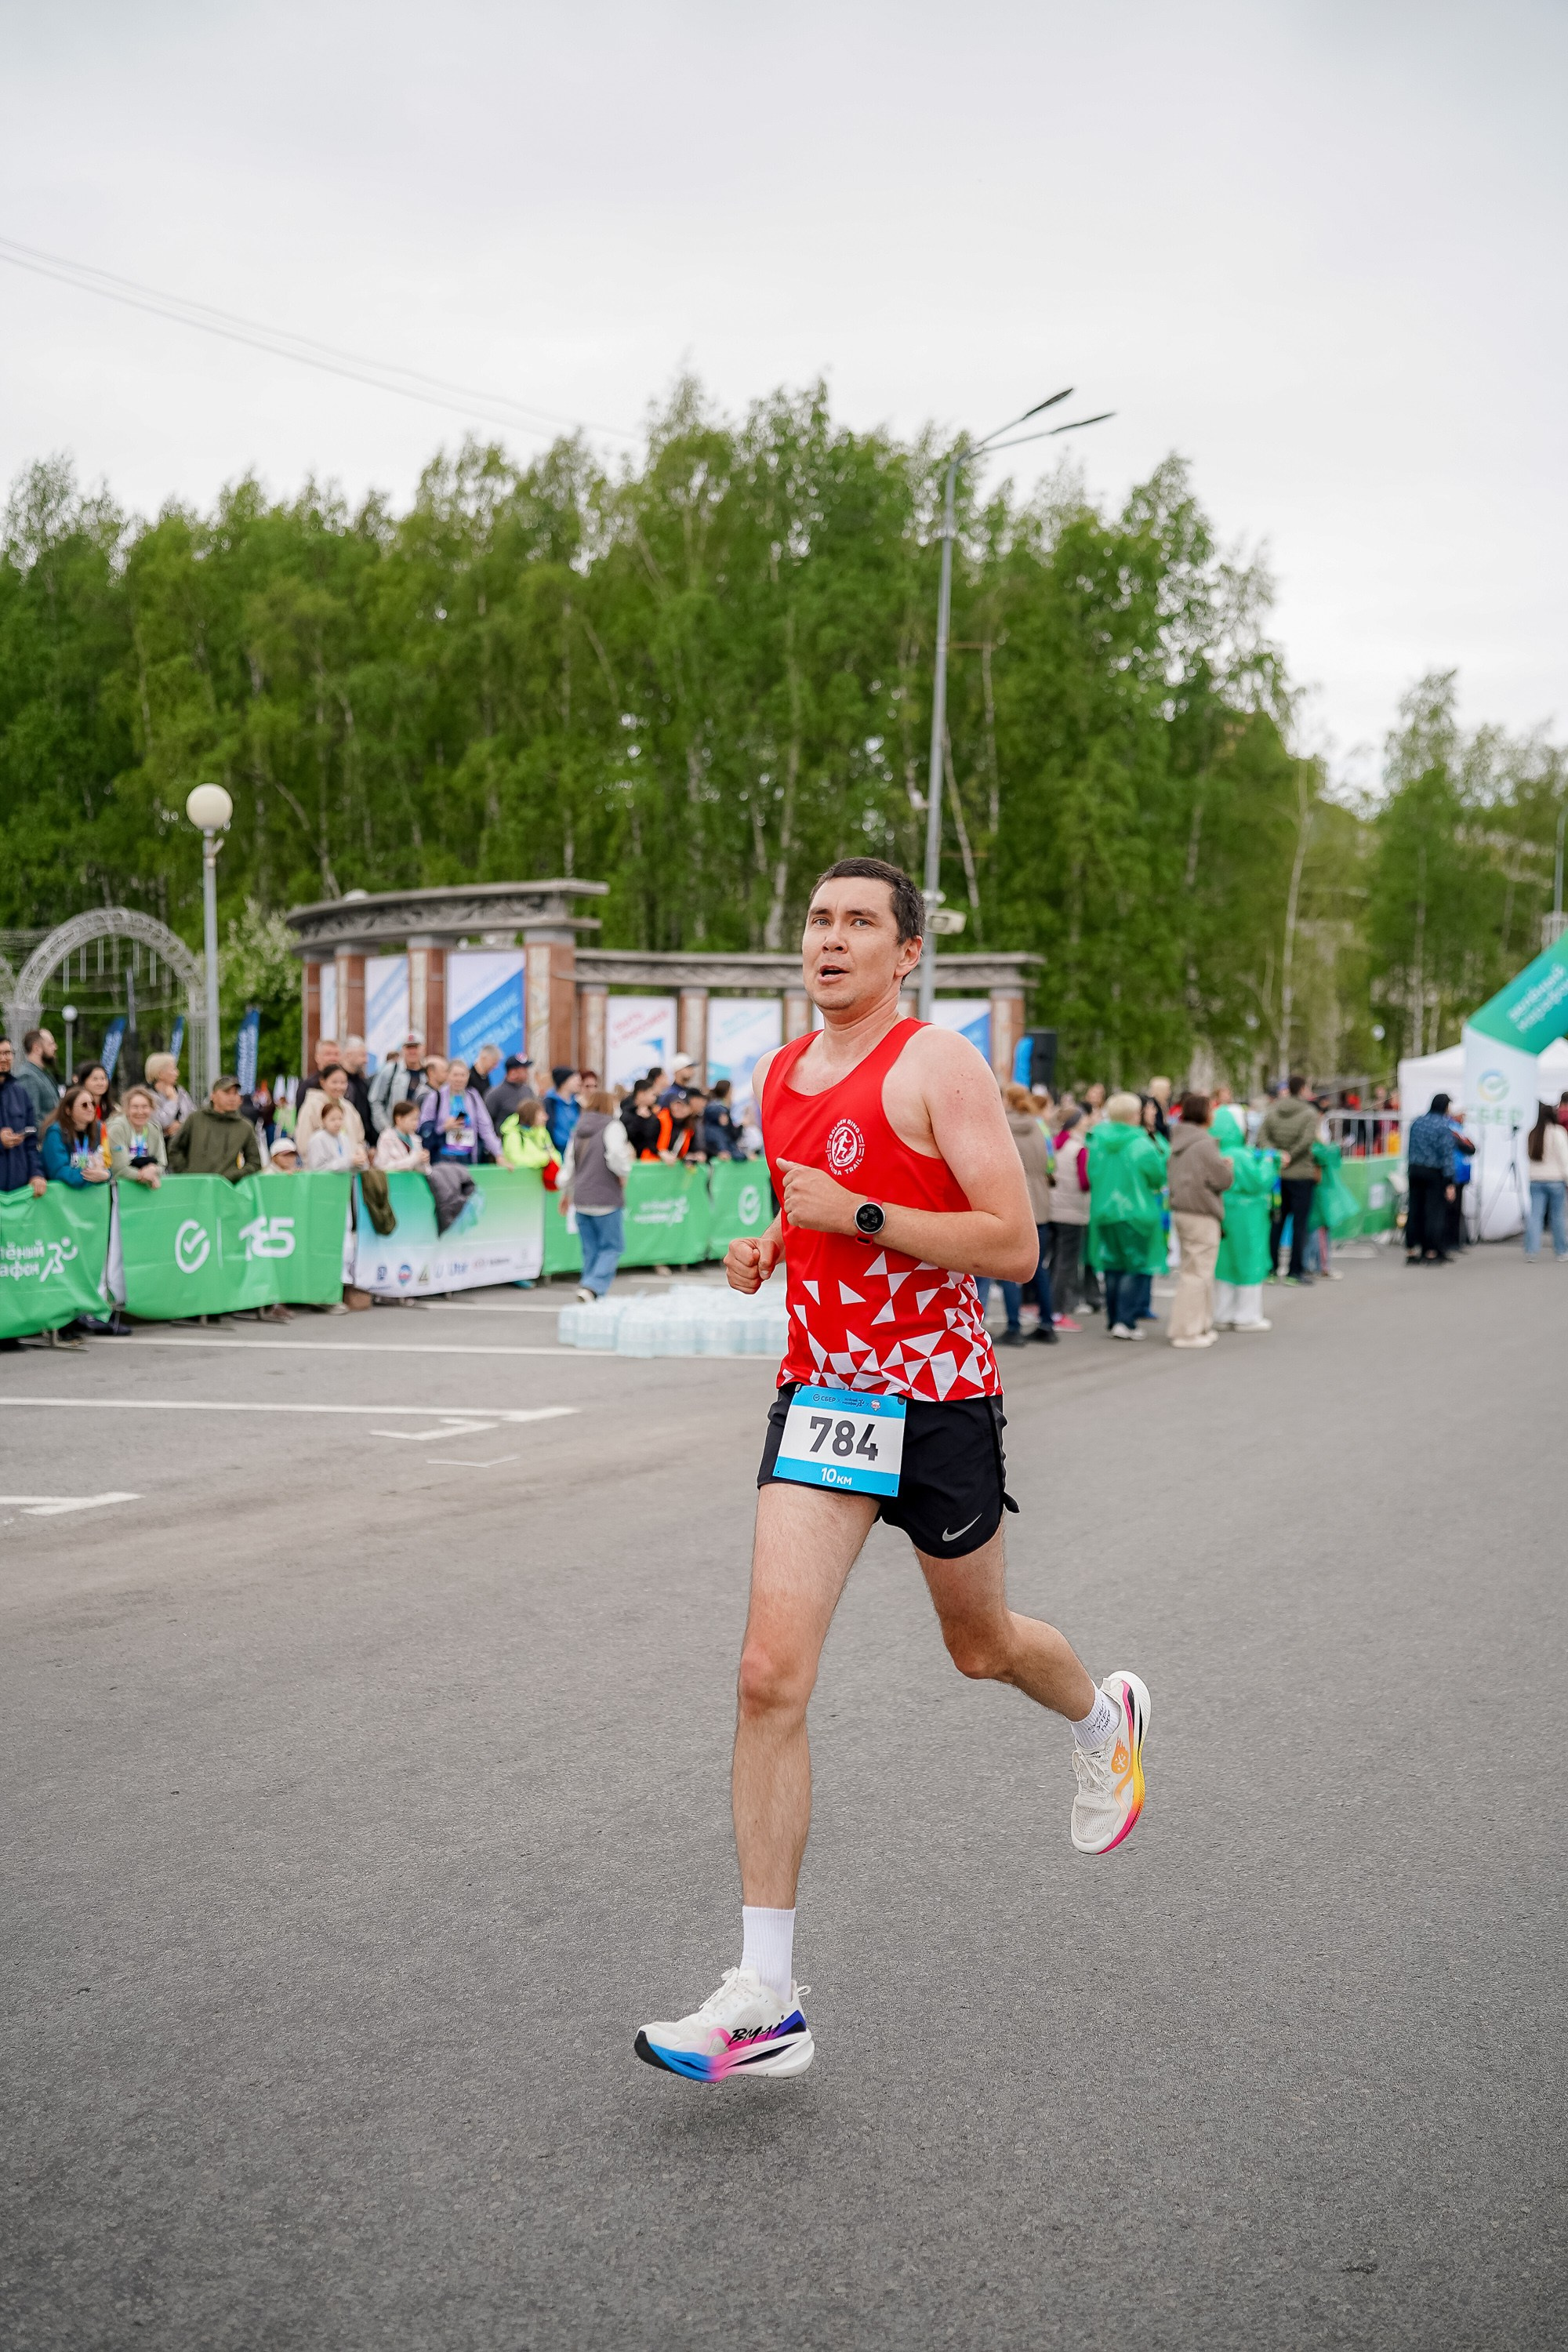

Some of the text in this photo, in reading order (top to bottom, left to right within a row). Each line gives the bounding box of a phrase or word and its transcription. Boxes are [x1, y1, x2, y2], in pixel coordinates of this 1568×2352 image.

[829, 1119, 860, 1139] GOLDEN RING
[829, 1158, 862, 1175] ULTRA TRAIL
[810, 1416, 878, 1461] 784
